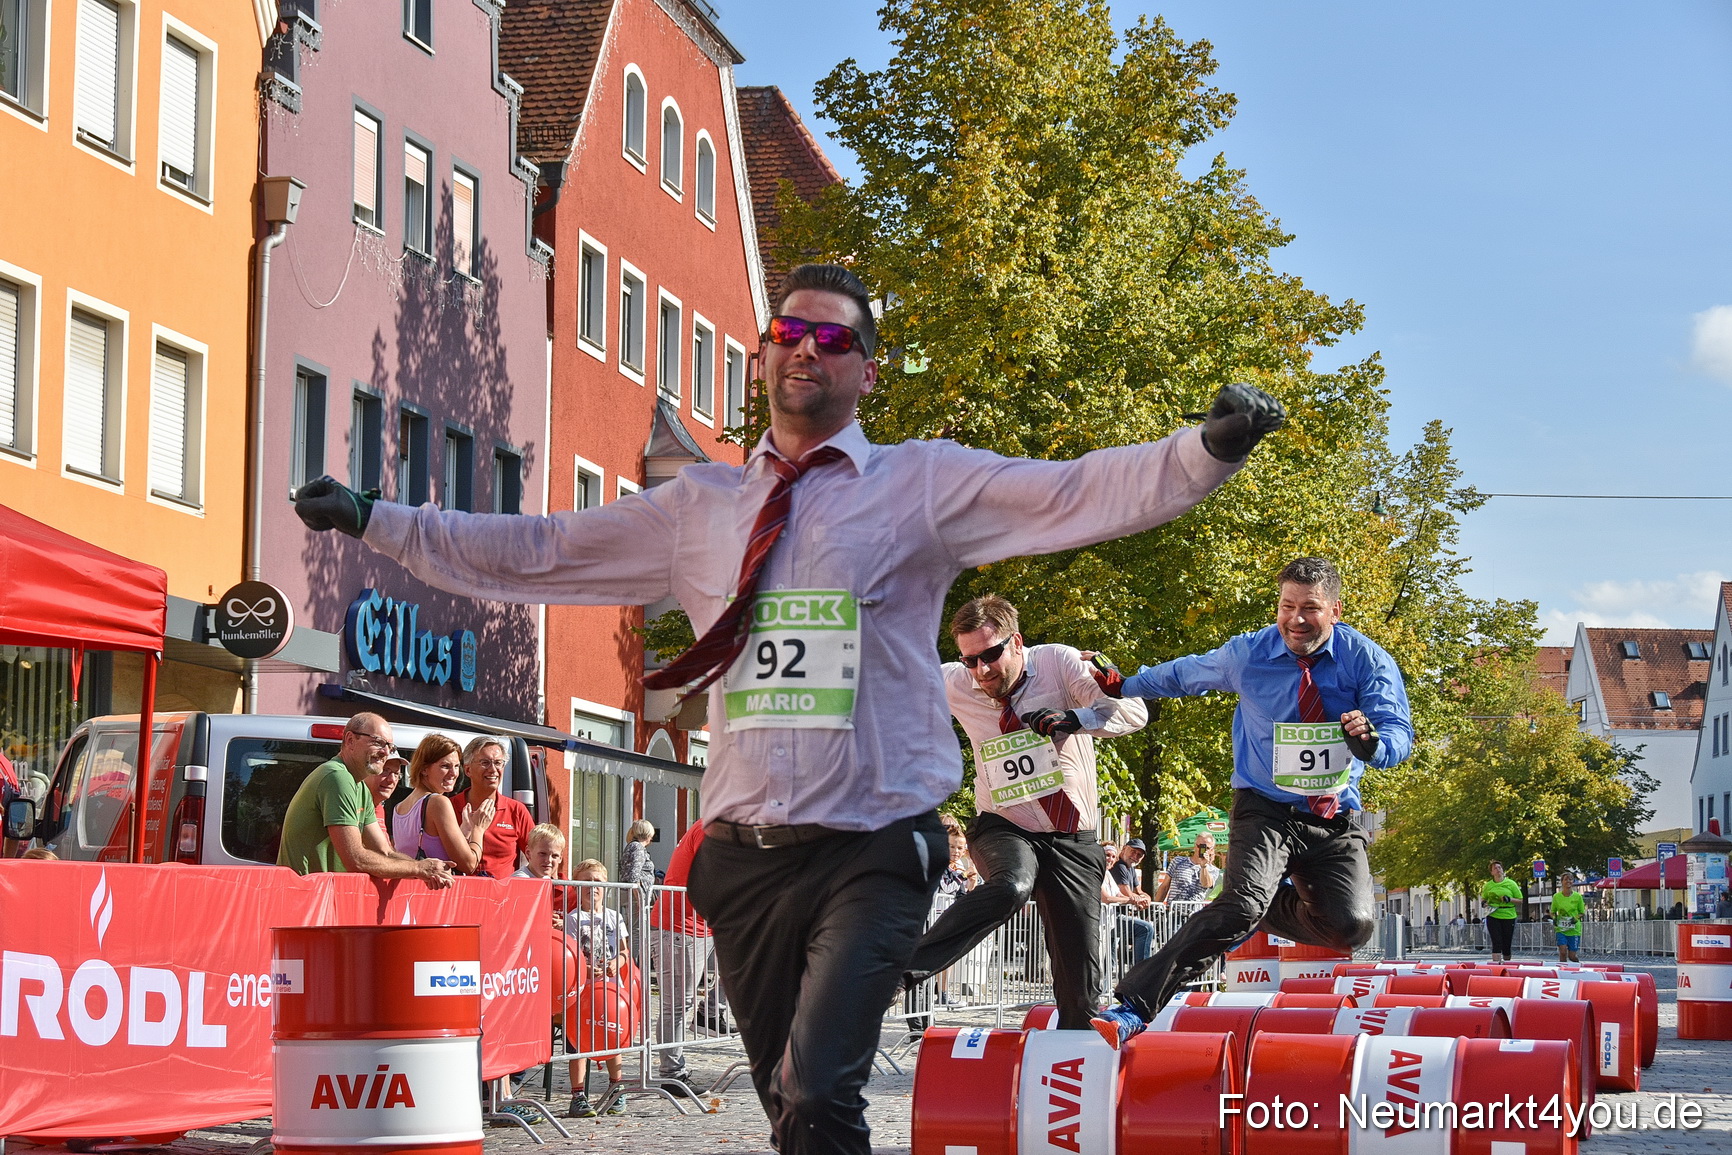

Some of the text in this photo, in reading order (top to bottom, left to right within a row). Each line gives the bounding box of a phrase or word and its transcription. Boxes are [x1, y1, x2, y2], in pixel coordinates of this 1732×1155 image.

[753, 594, 847, 628] OCK
[221, 629, 281, 641] hunkemöller
[355, 588, 453, 687] Eilles
[755, 638, 806, 680] 92
[746, 693, 816, 712] MARIO
[982, 731, 1045, 759] BOCK
[1281, 726, 1344, 743] BOCK
[1003, 754, 1035, 781] 90
[1299, 748, 1330, 772] 91
[997, 775, 1056, 801] MATTHIAS
[1292, 775, 1339, 788] ADRIAN
[482, 966, 540, 1000] energie
[1237, 967, 1271, 984] AVIA
[311, 1064, 416, 1110] AVIA
[1041, 1057, 1085, 1154] AVIA
